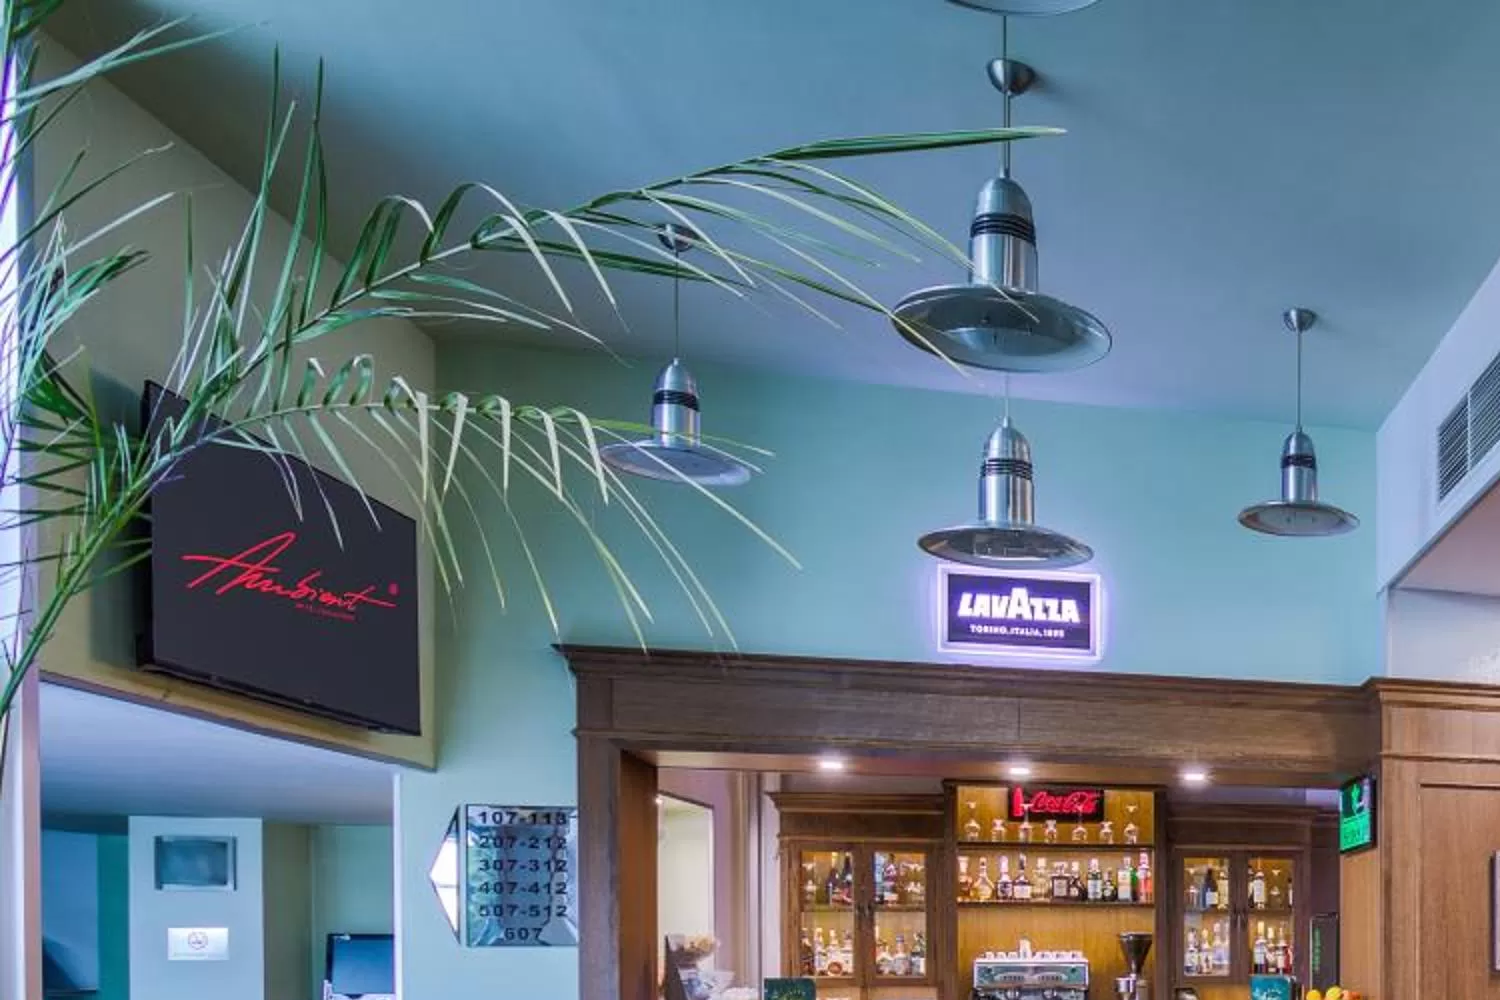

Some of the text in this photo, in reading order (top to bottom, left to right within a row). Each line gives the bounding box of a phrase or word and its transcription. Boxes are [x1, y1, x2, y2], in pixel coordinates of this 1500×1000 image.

[957, 587, 1081, 623] LAVAZZA
[479, 835, 567, 849] 207-212
[479, 859, 567, 872] 307-312
[479, 882, 567, 894] 407-412
[504, 927, 543, 940] 607
